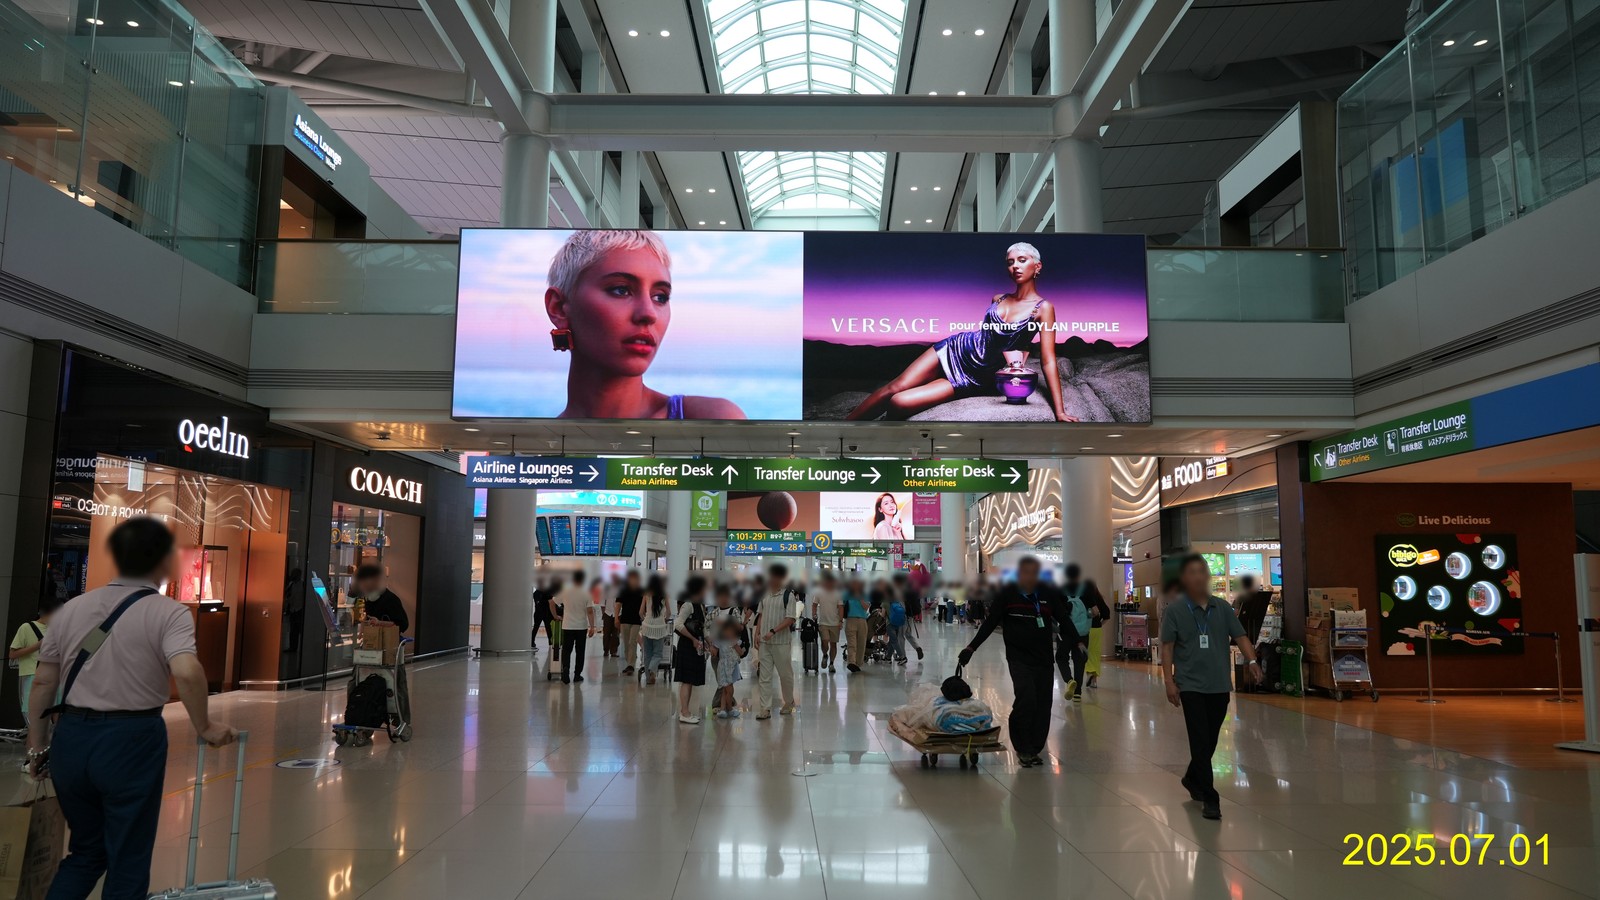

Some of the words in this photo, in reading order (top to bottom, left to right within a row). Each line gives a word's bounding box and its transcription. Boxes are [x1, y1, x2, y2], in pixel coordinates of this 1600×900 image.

[294, 113, 319, 145] Asiana
[319, 135, 342, 166] Lounge
[831, 318, 940, 334] VERSACE
[949, 321, 976, 334] pour
[978, 320, 1018, 332] femme
[1027, 321, 1068, 332] DYLAN
[1071, 321, 1120, 333] PURPLE
[1400, 421, 1432, 439] Transfer
[1433, 413, 1466, 431] Lounge
[1337, 438, 1361, 454] Transfer
[1362, 434, 1378, 449] Desk
[1338, 456, 1352, 467] Other
[1352, 453, 1370, 464] Airlines
[473, 461, 516, 475] Airline
[519, 462, 574, 477] Lounges
[621, 463, 679, 476] Transfer
[681, 463, 714, 476] Desk
[754, 466, 805, 480] Transfer
[808, 467, 856, 484] Lounge
[902, 465, 960, 477] Transfer
[962, 465, 995, 477] Desk
[1174, 461, 1203, 488] FOOD
[350, 466, 423, 504] COACH
[493, 476, 517, 484] Airlines
[519, 477, 549, 485] Singapore
[550, 477, 573, 485] Airlines
[621, 478, 647, 486] Asiana
[648, 478, 678, 486] Airlines
[903, 479, 926, 487] Other
[927, 479, 957, 487] Airlines
[1418, 515, 1440, 525] Live
[1442, 515, 1491, 525] Delicious
[735, 532, 767, 540] 101-291
[735, 543, 758, 551] 29-41
[780, 543, 798, 551] 5-28
[1391, 549, 1417, 561] bibigo
